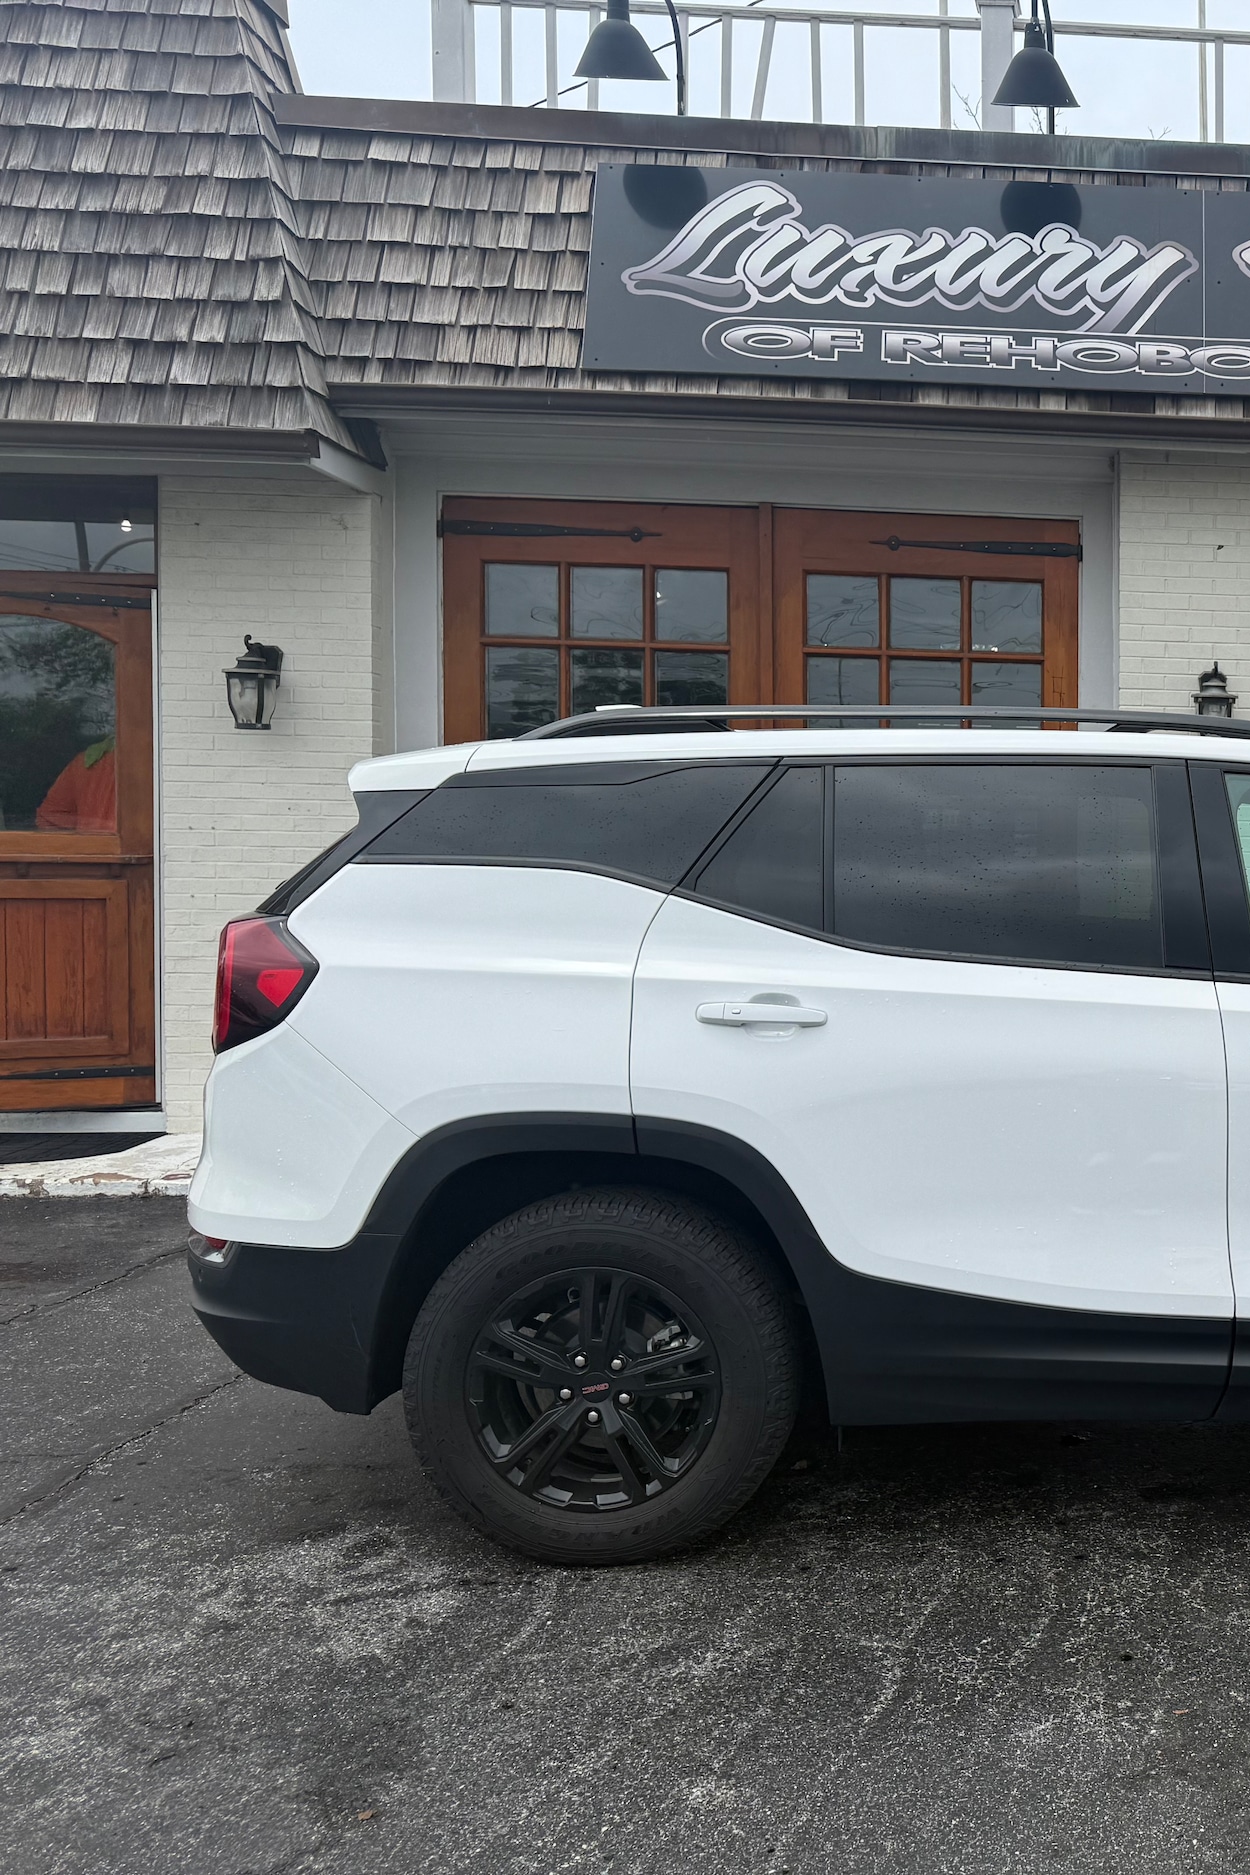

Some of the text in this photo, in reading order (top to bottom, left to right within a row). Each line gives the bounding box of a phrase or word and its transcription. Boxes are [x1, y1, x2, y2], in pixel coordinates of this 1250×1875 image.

[620, 180, 1199, 335] Luxury
[720, 325, 864, 361] OF
[582, 1382, 610, 1394] GMC
